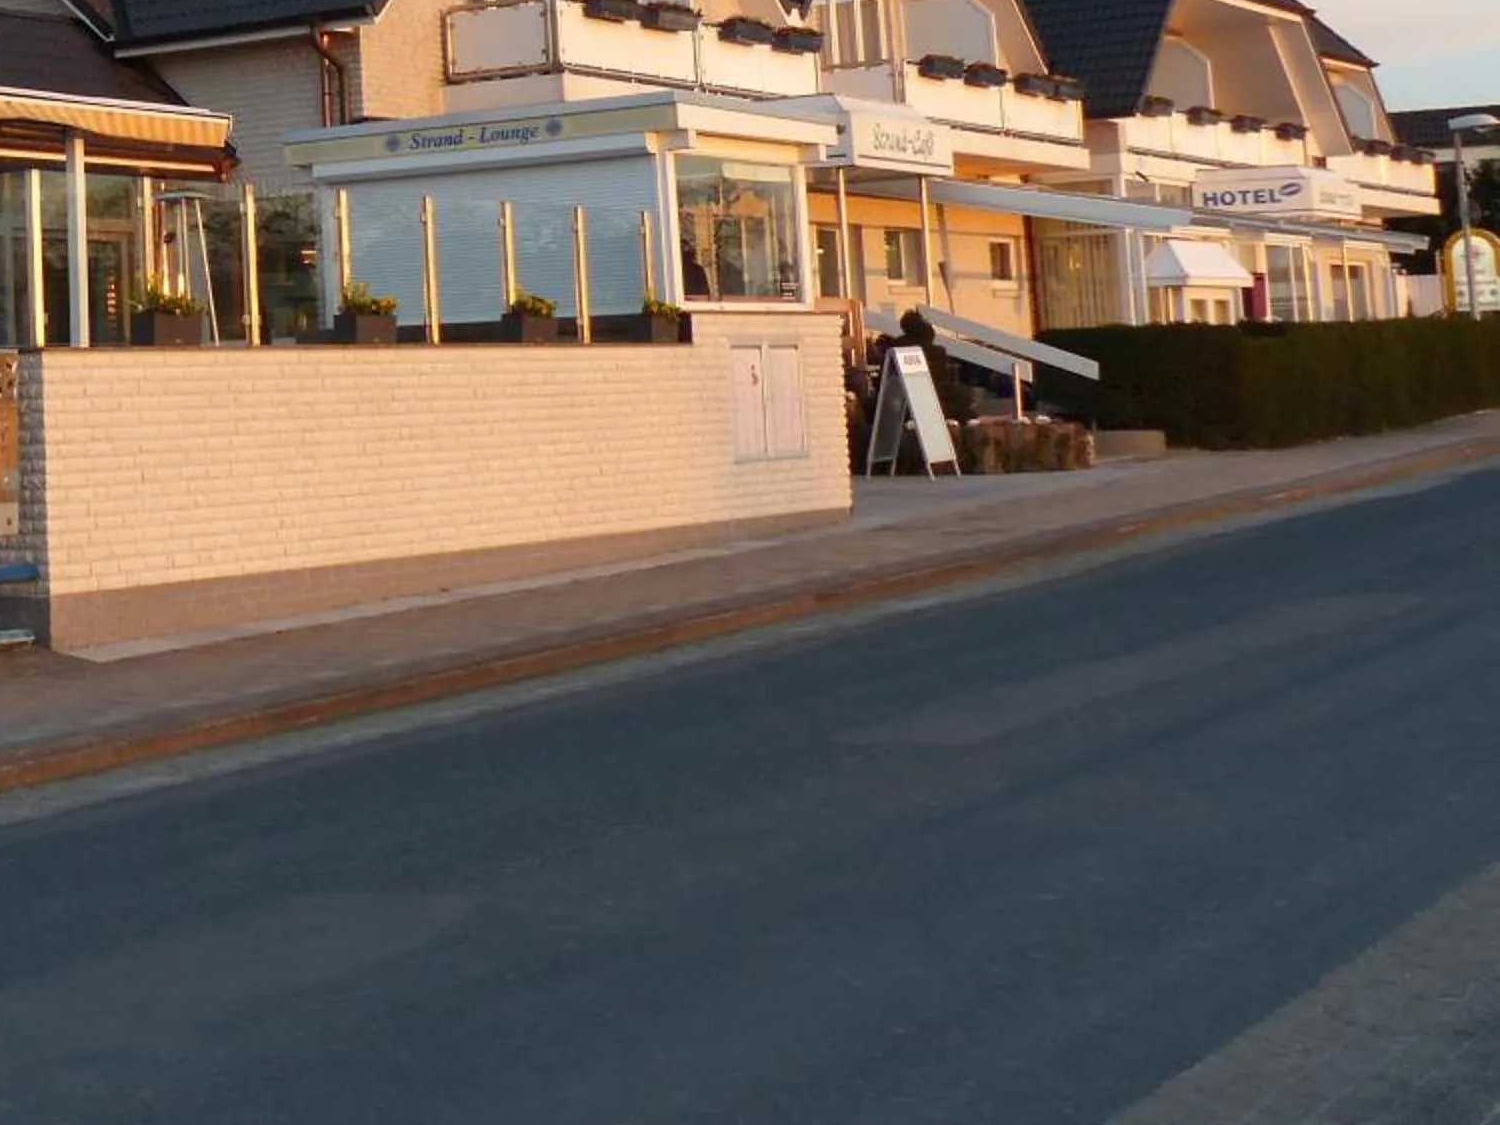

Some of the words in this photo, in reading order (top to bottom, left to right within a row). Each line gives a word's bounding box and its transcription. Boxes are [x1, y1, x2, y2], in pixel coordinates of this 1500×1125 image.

[408, 129, 464, 150] Strand
[478, 125, 540, 145] Lounge
[1202, 188, 1283, 207] HOTEL
